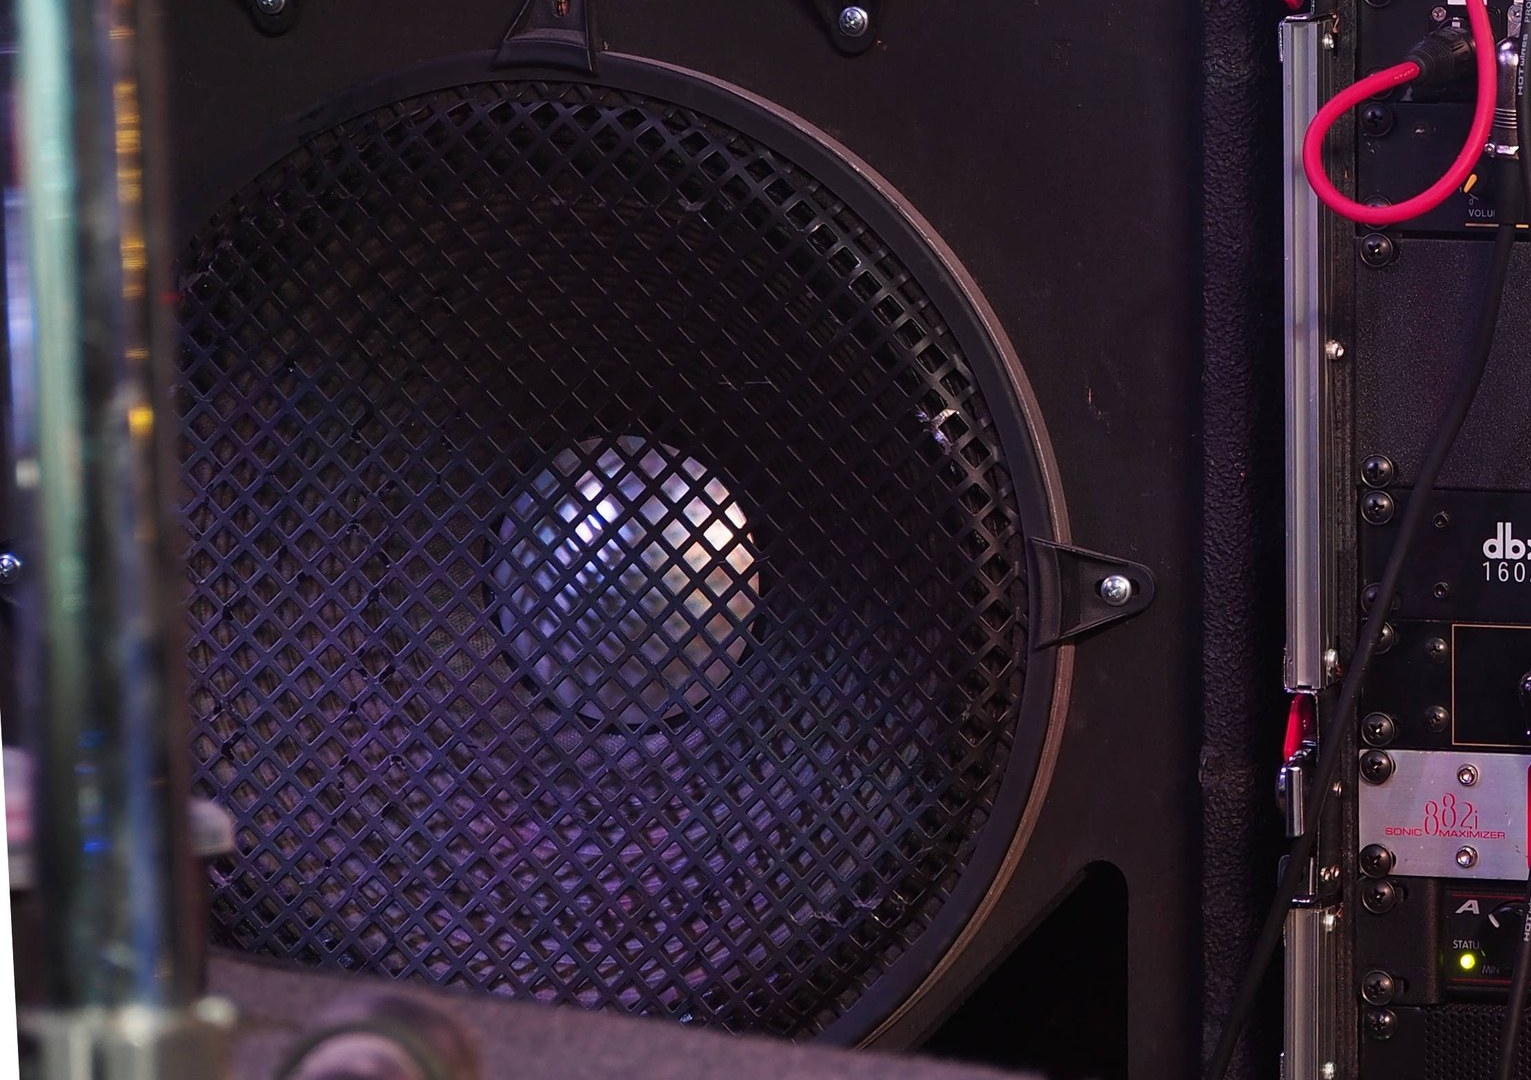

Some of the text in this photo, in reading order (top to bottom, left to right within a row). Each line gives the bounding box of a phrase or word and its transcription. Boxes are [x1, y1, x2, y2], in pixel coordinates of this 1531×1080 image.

[1385, 828, 1505, 839] SONIC MAXIMIZER
[1455, 899, 1480, 915] A
